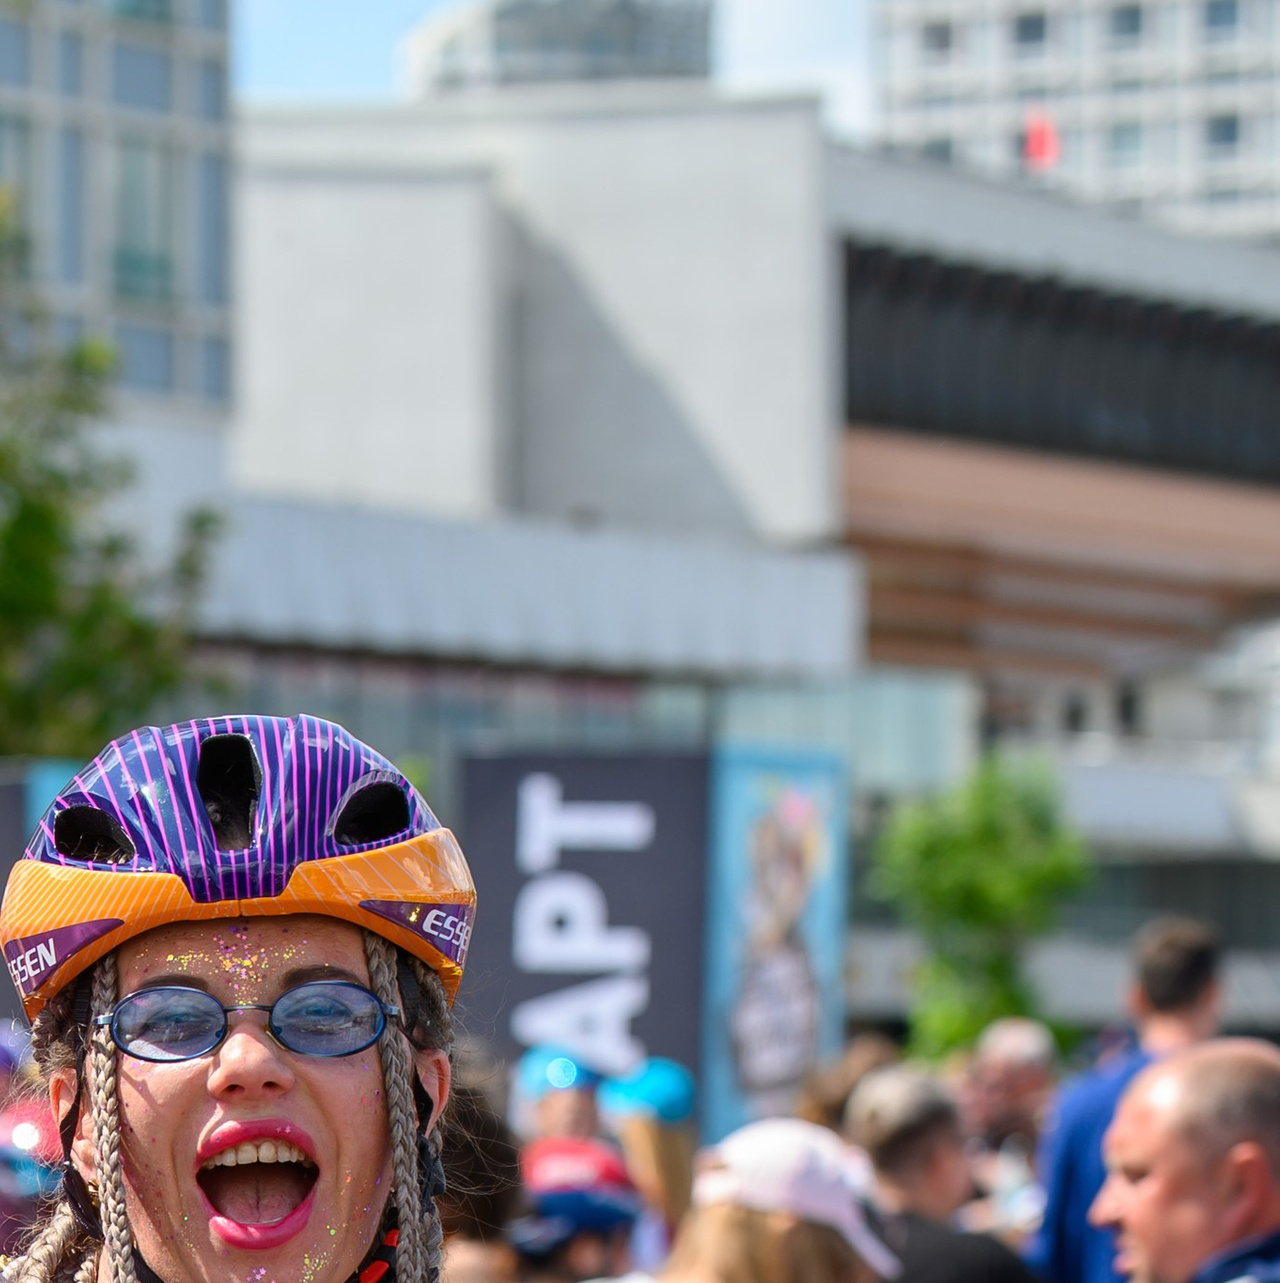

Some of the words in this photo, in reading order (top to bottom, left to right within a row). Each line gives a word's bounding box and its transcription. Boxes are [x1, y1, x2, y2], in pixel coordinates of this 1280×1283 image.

[422, 909, 471, 952] ESSE
[8, 938, 57, 987] SSEN
[509, 772, 656, 1140] АРТ
